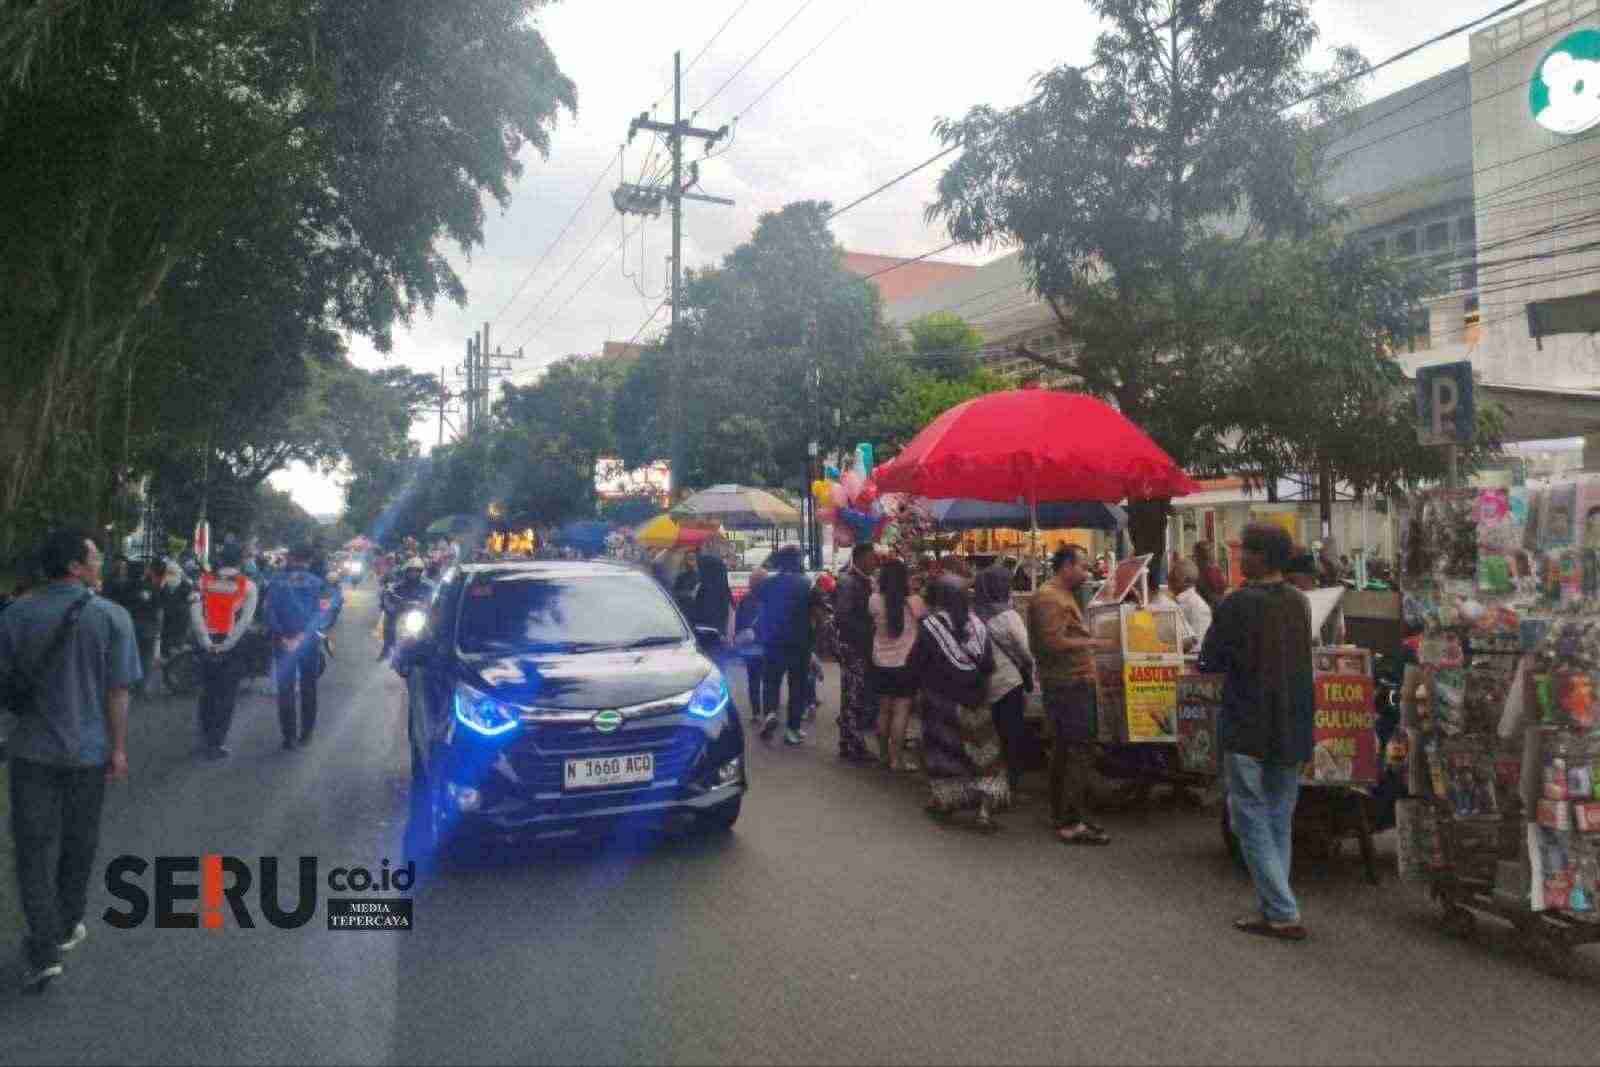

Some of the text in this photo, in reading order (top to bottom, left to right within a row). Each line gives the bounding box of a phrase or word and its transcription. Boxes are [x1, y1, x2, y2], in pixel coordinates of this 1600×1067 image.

[1432, 377, 1457, 433] P
[1323, 683, 1363, 703] TELOR
[567, 763, 577, 779] N
